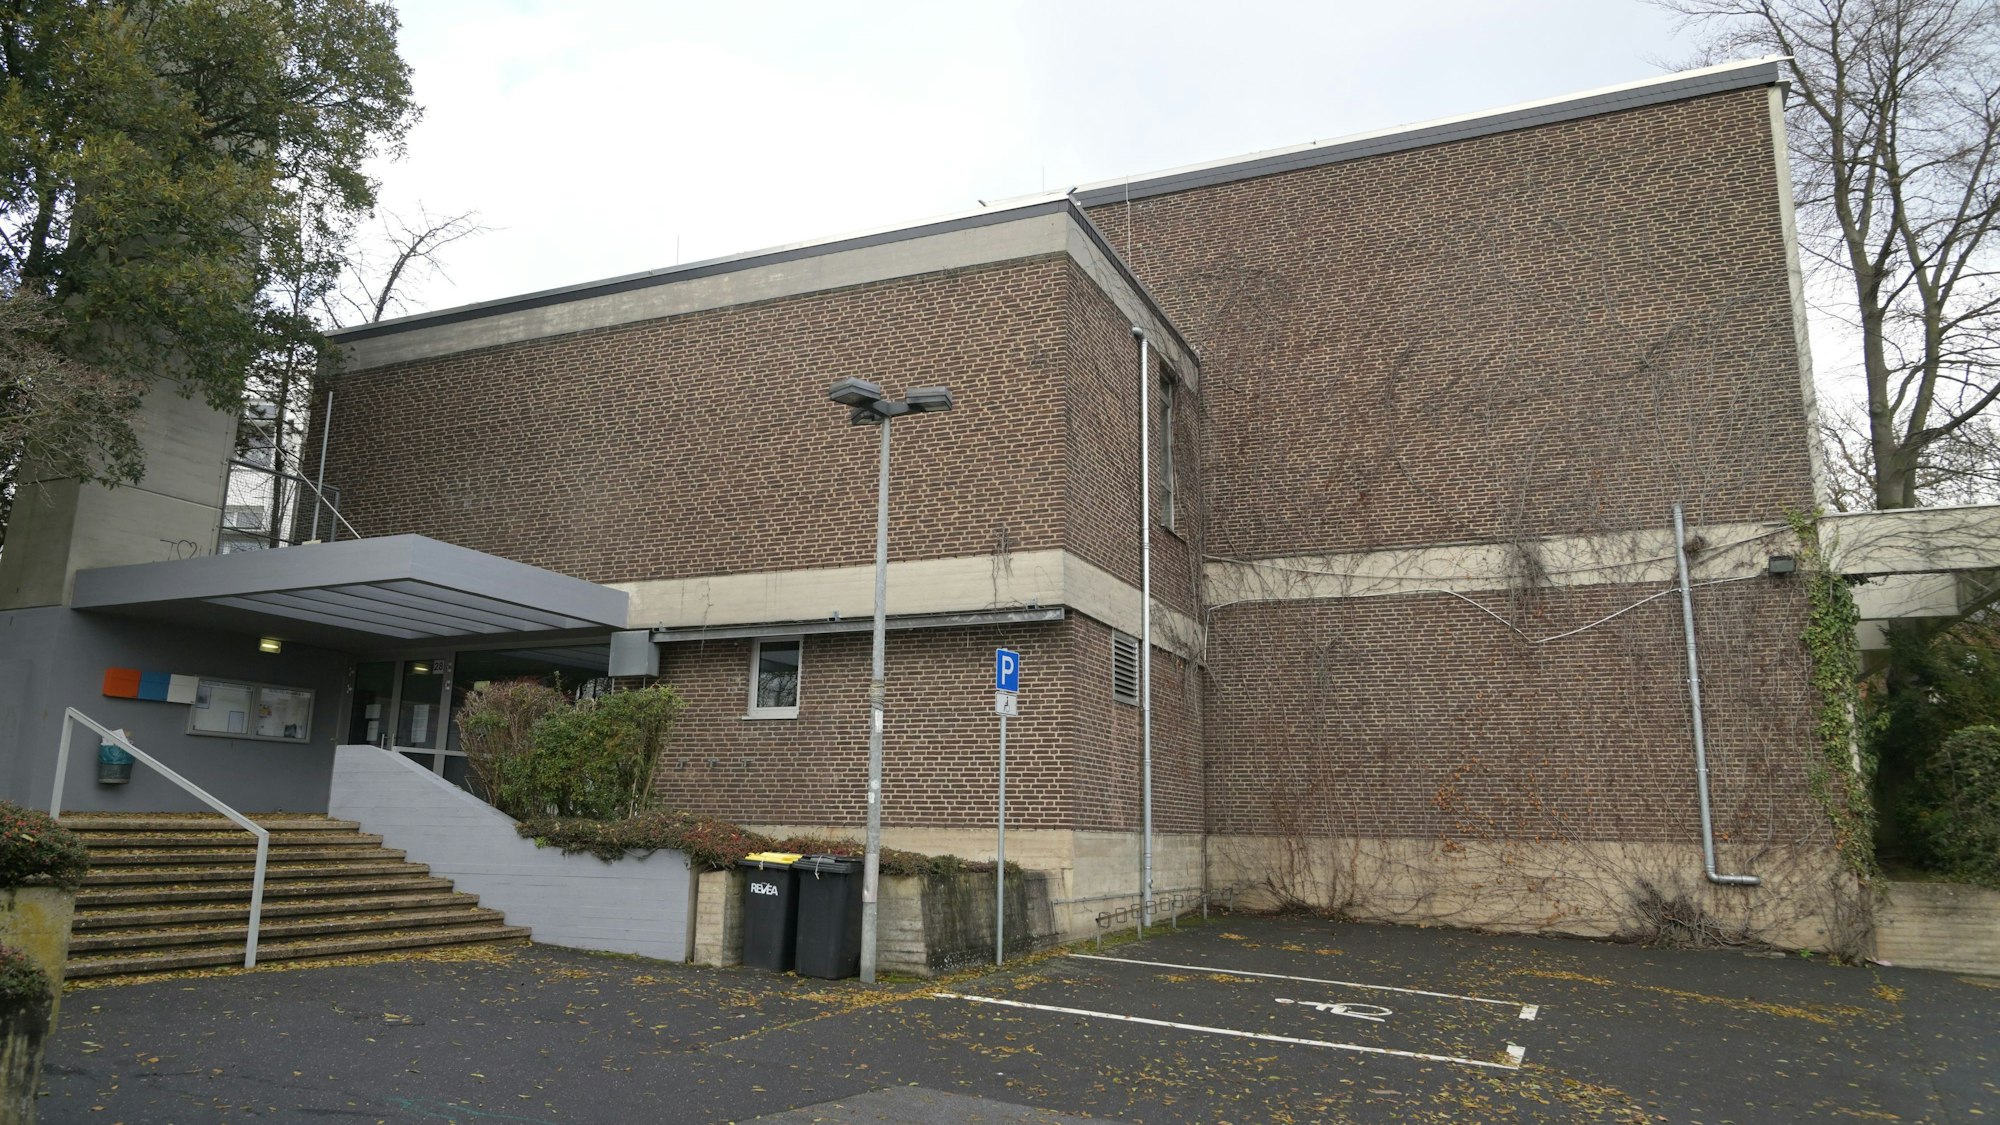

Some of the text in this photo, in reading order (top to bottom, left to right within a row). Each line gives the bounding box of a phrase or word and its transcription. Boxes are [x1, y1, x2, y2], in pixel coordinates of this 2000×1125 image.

[434, 662, 443, 671] 28
[1002, 655, 1014, 685] P
[751, 882, 778, 896] REVEA
